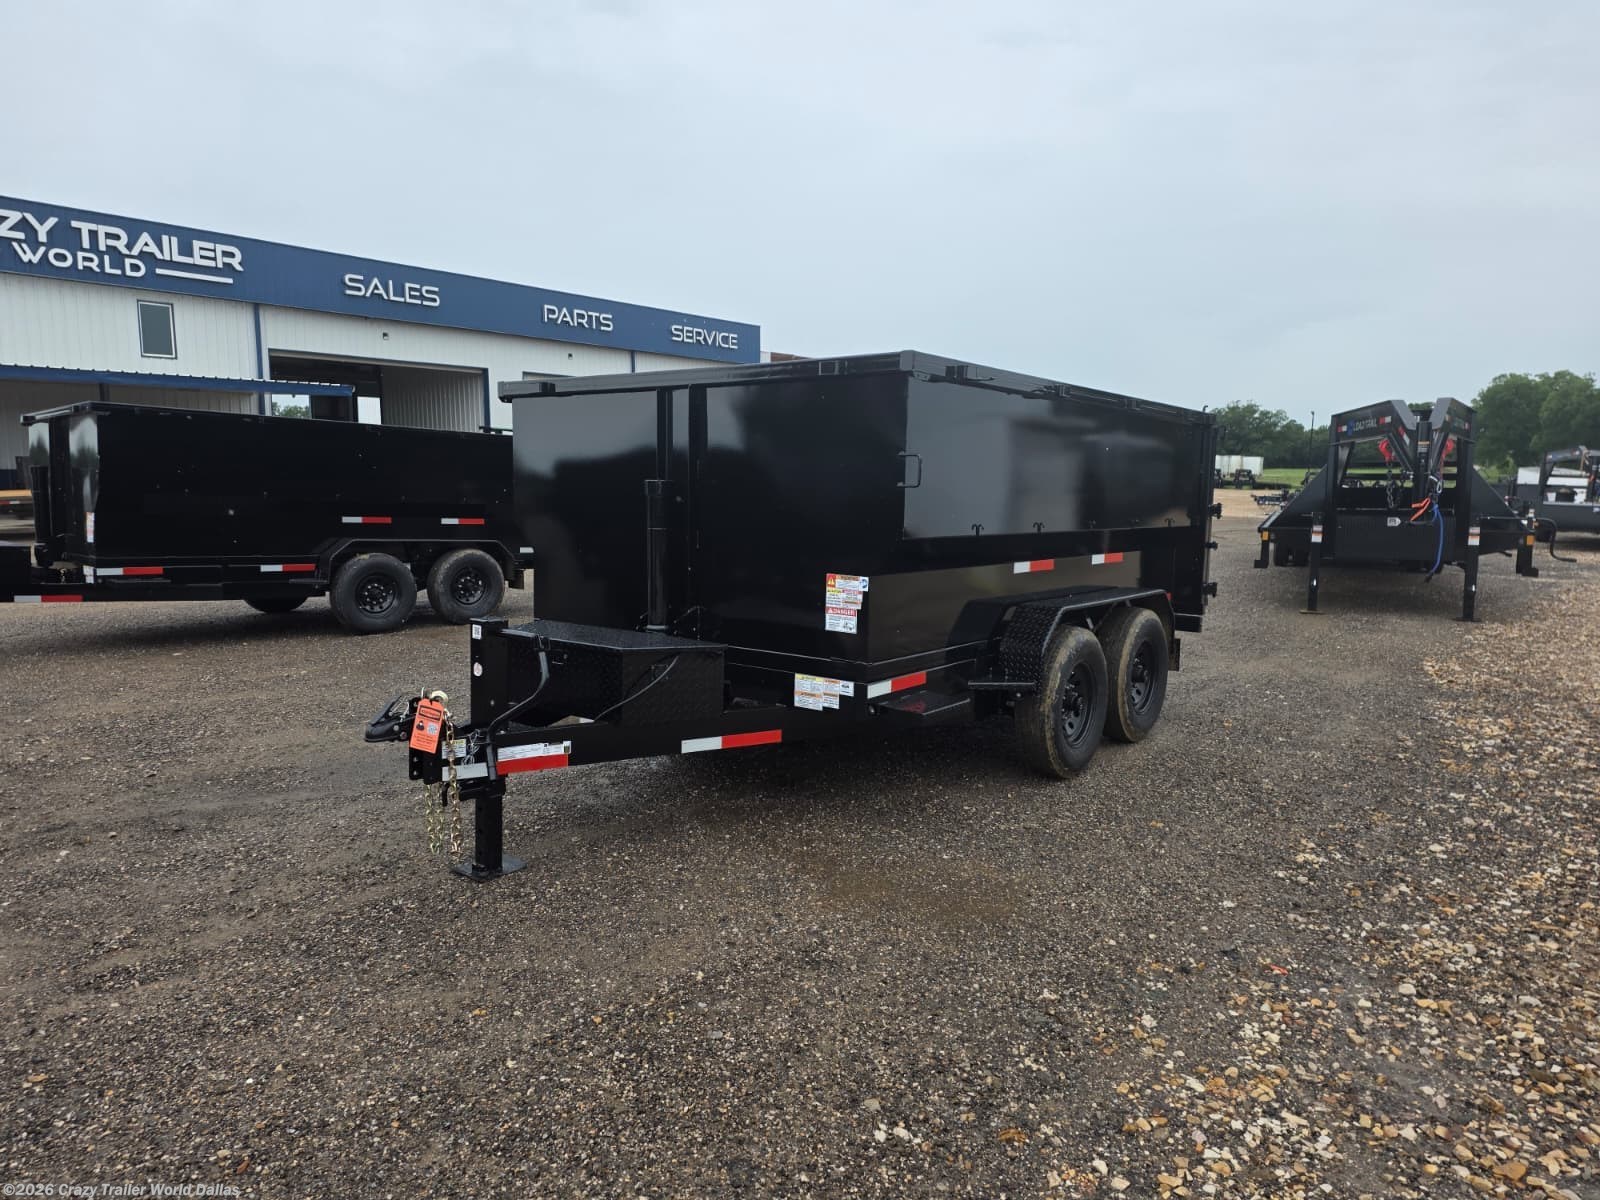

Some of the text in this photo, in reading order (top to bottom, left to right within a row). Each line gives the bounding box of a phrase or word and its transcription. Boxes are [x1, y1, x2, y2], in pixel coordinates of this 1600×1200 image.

[11, 241, 146, 277] WORLD
[70, 220, 244, 272] TRAILER
[344, 273, 440, 307] SALES
[543, 304, 614, 332] PARTS
[671, 325, 738, 349] SERVICE
